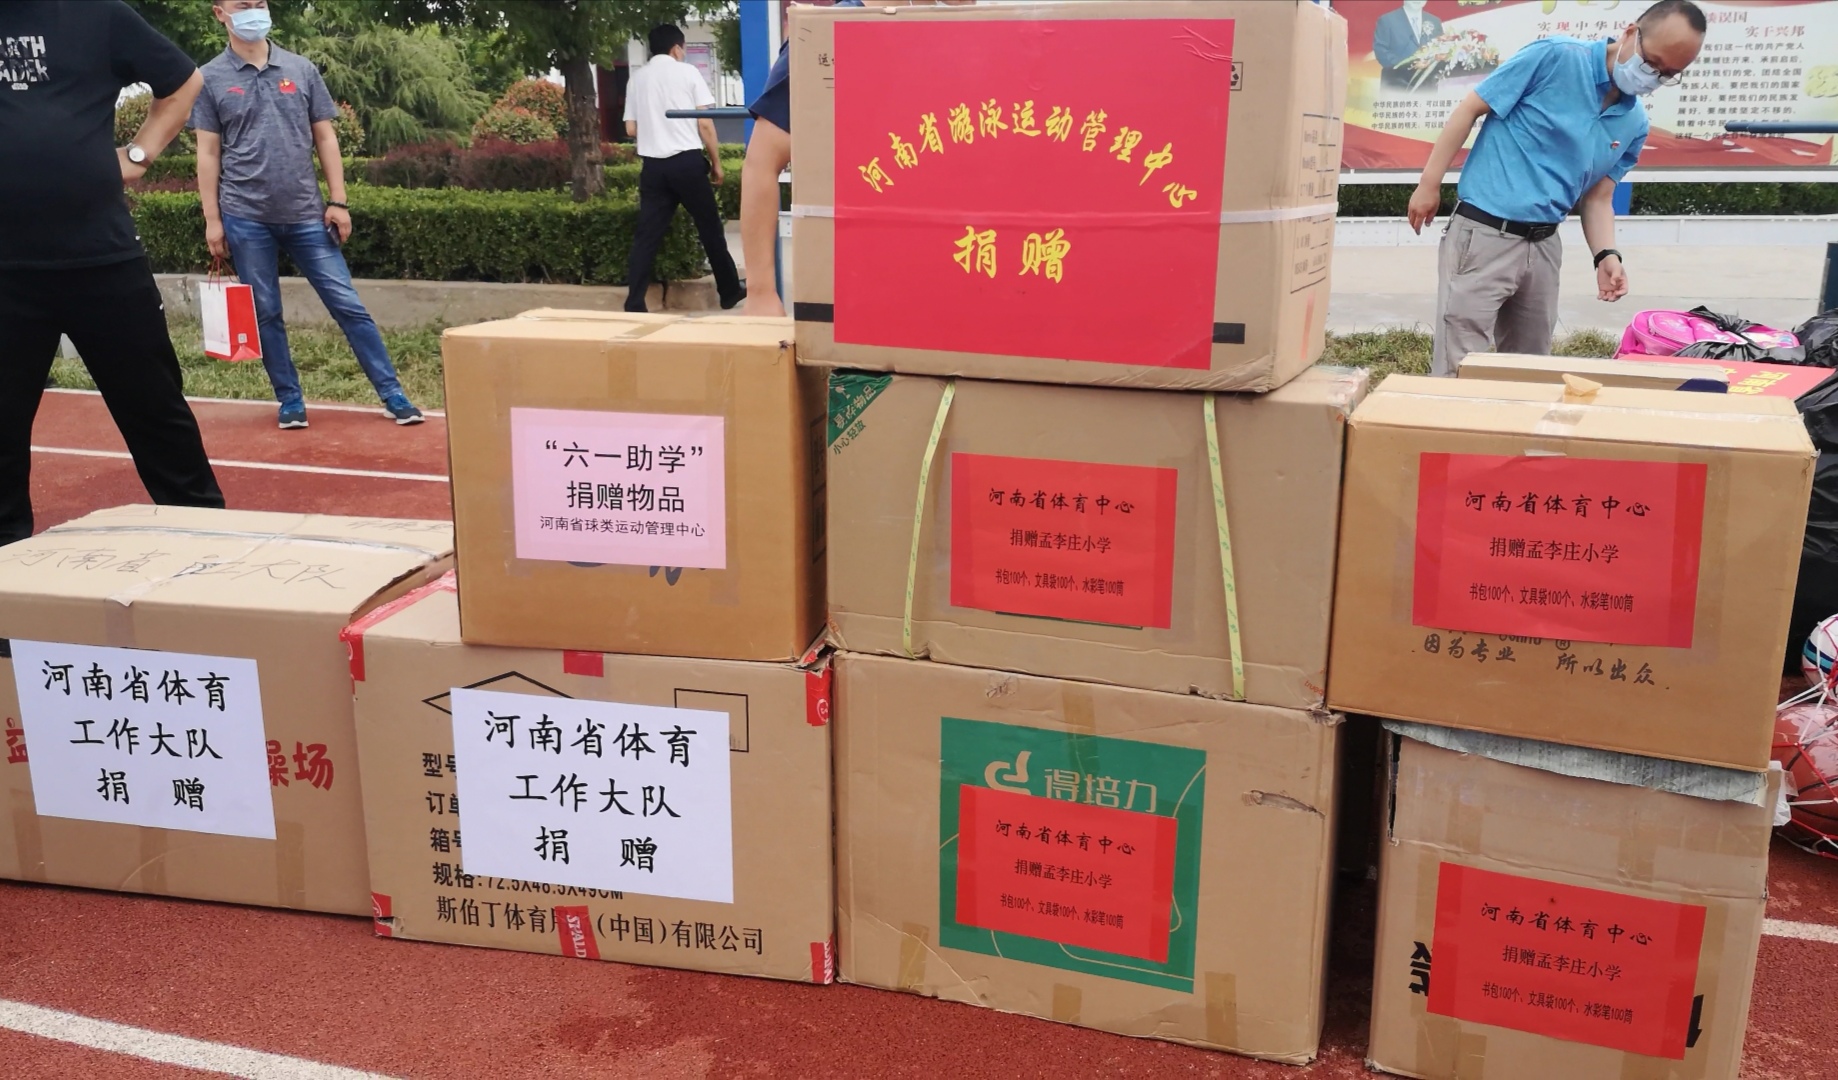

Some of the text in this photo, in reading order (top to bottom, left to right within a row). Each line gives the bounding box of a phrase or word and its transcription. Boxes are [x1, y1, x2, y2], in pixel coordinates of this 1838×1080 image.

[1745, 25, 1806, 38] 实干兴邦
[858, 98, 1198, 208] 河南省游泳运动管理中心
[953, 225, 1071, 283] 捐赠
[545, 439, 703, 474] “六一助学”
[567, 480, 685, 513] 捐赠物品
[988, 487, 1135, 516] 河南省体育中心
[1464, 490, 1651, 520] 河南省体育中心
[540, 515, 706, 538] 河南省球类运动管理中心
[1009, 528, 1112, 554] 捐赠孟李庄小学
[1489, 537, 1620, 564] 捐赠孟李庄小学
[995, 569, 1125, 597] 书包100个、文具袋100个、水彩笔100筒
[1469, 582, 1634, 613] 书包100个、文具袋100个、水彩笔100筒
[1424, 633, 1656, 686] 因为专业 所以出众
[41, 660, 231, 712] 河南省体育
[70, 717, 224, 759] 工作大队
[484, 711, 698, 768] 河南省体育
[97, 768, 206, 812] 捐赠
[508, 774, 682, 818] 工作大队
[1044, 768, 1158, 813] 得培力
[534, 826, 659, 874] 捐赠
[995, 819, 1136, 855] 河南省体育中心
[1014, 858, 1113, 889] 捐赠孟李庄小学
[1000, 893, 1124, 930] 书包100个、文具袋100个、水彩笔100筒
[1481, 902, 1653, 946] 河南省体育中心
[1502, 945, 1622, 981] 捐赠孟李庄小学
[1481, 981, 1634, 1025] 书包100个、文具袋100个、水彩笔100筒
